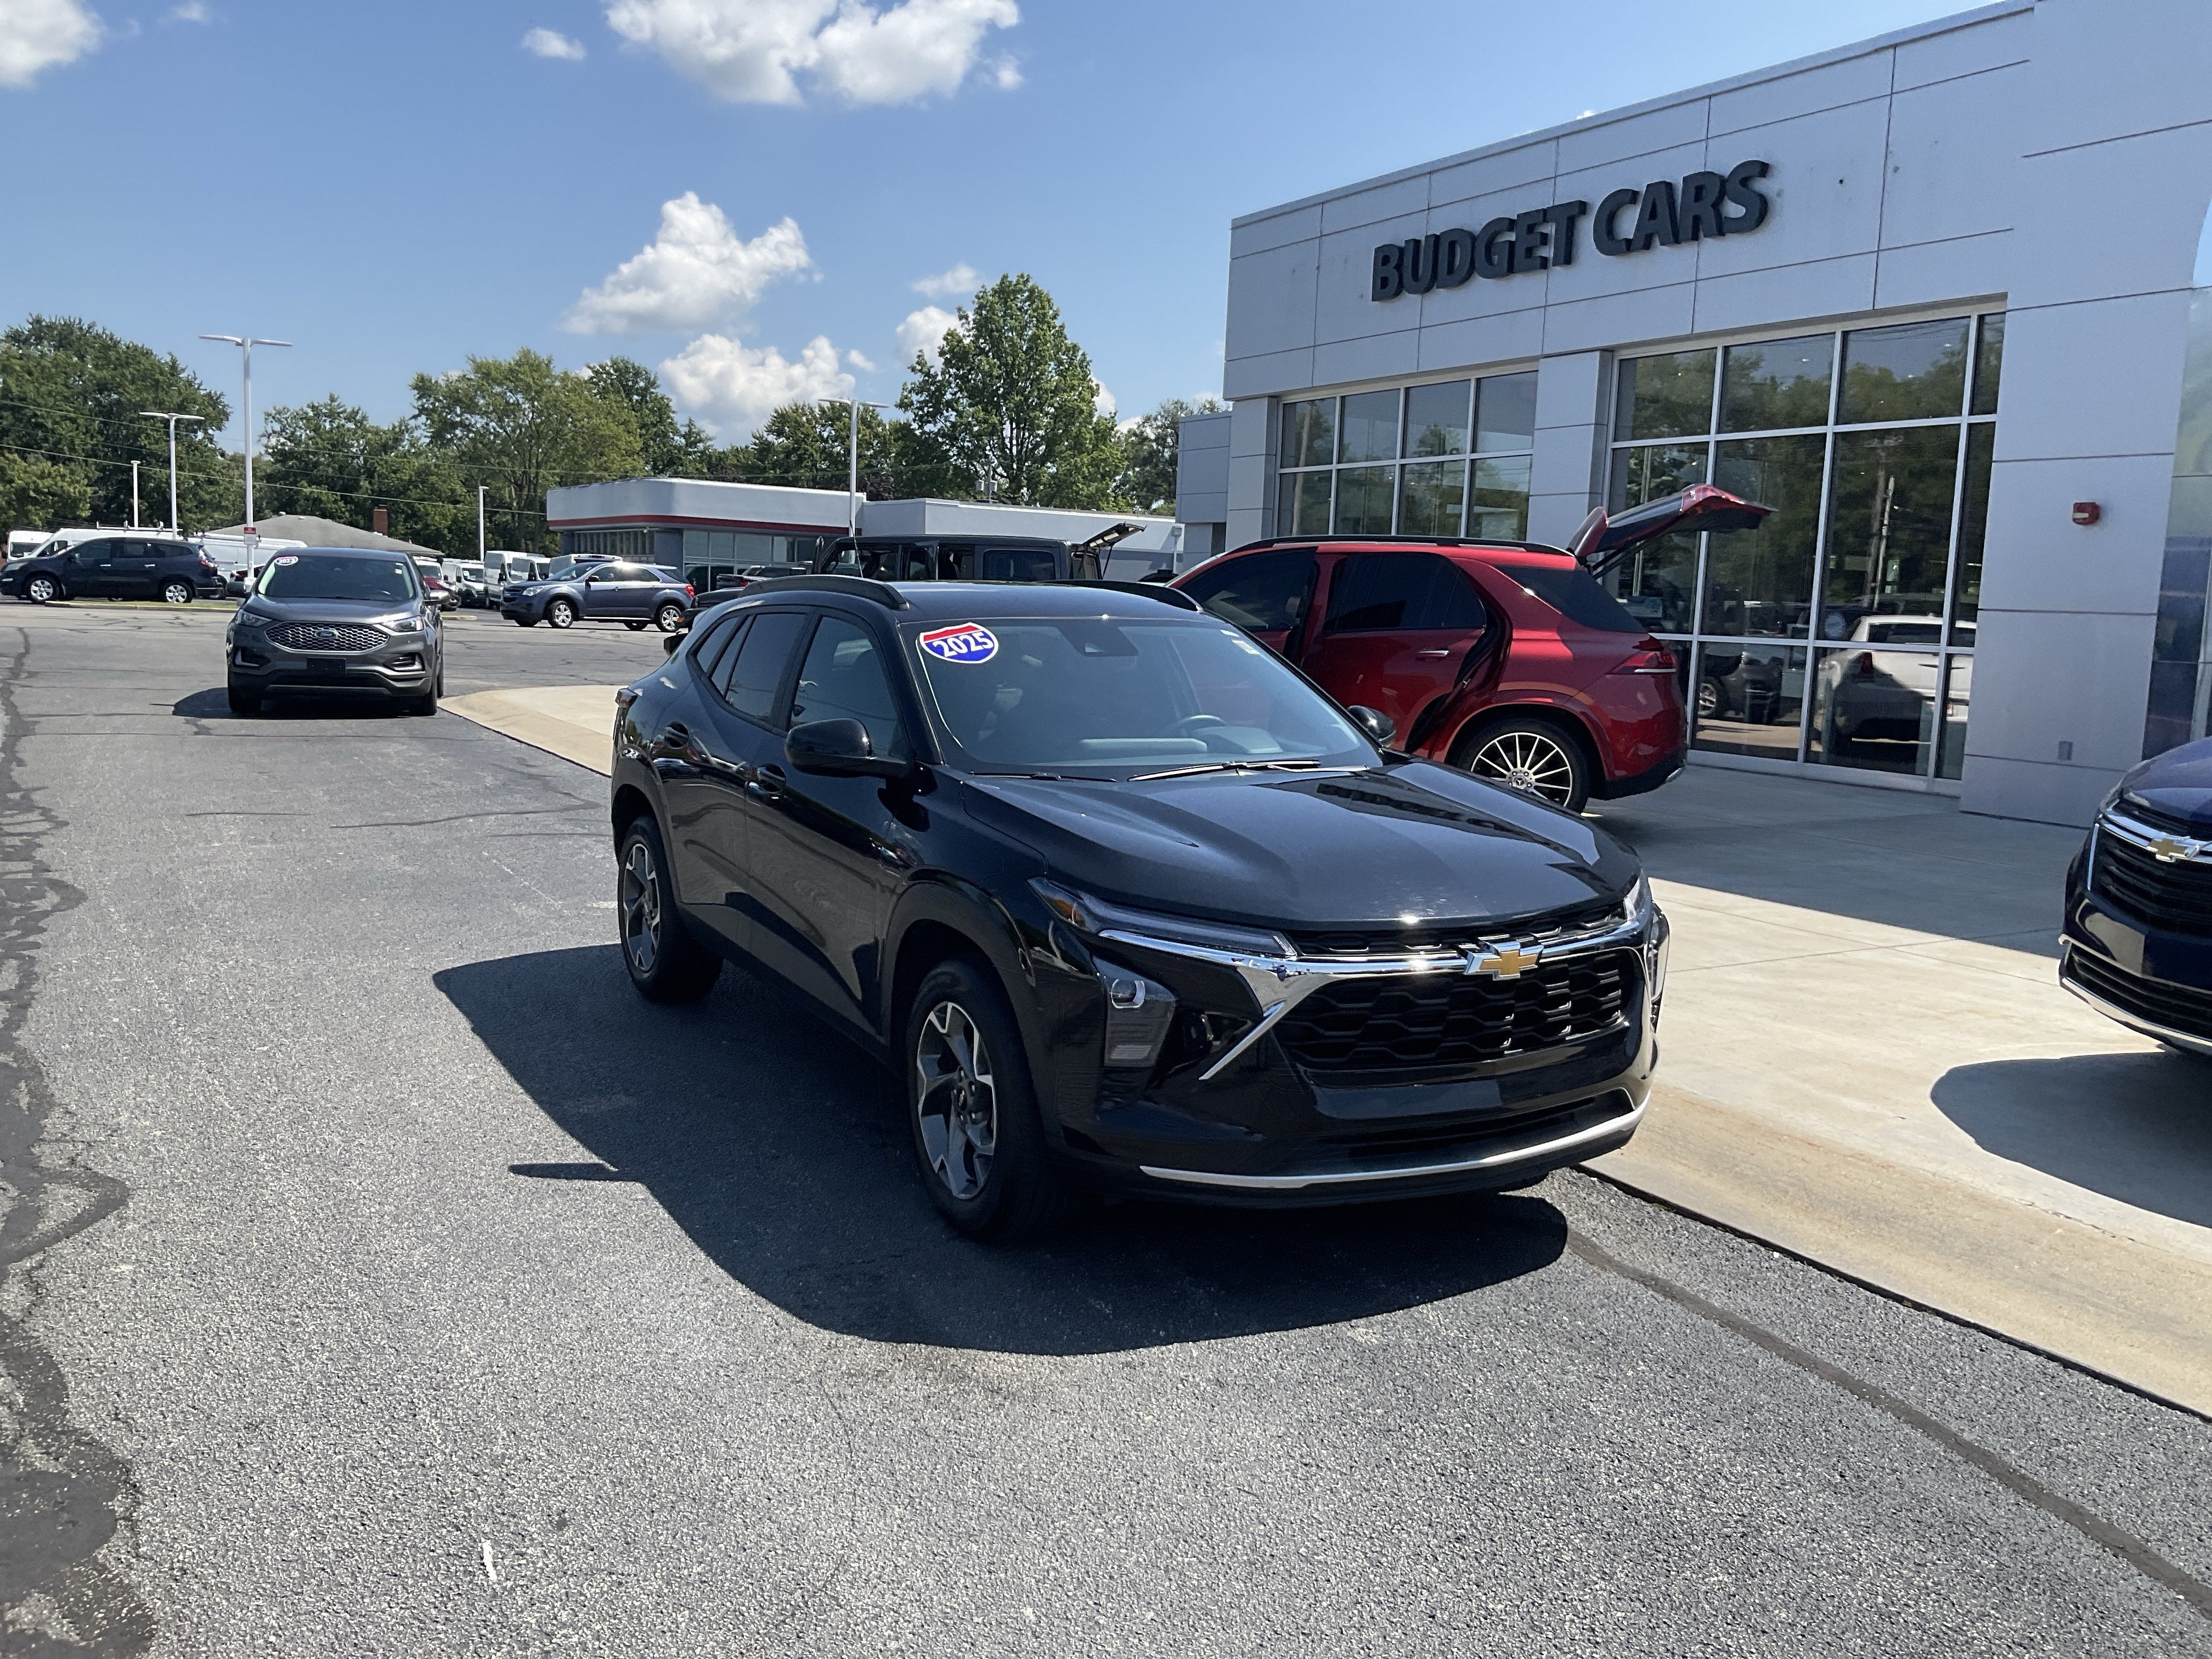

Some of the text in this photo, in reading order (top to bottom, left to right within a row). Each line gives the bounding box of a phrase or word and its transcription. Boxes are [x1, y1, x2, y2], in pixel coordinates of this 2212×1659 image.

[1372, 160, 1769, 301] BUDGET CARS
[933, 632, 994, 657] 2025
